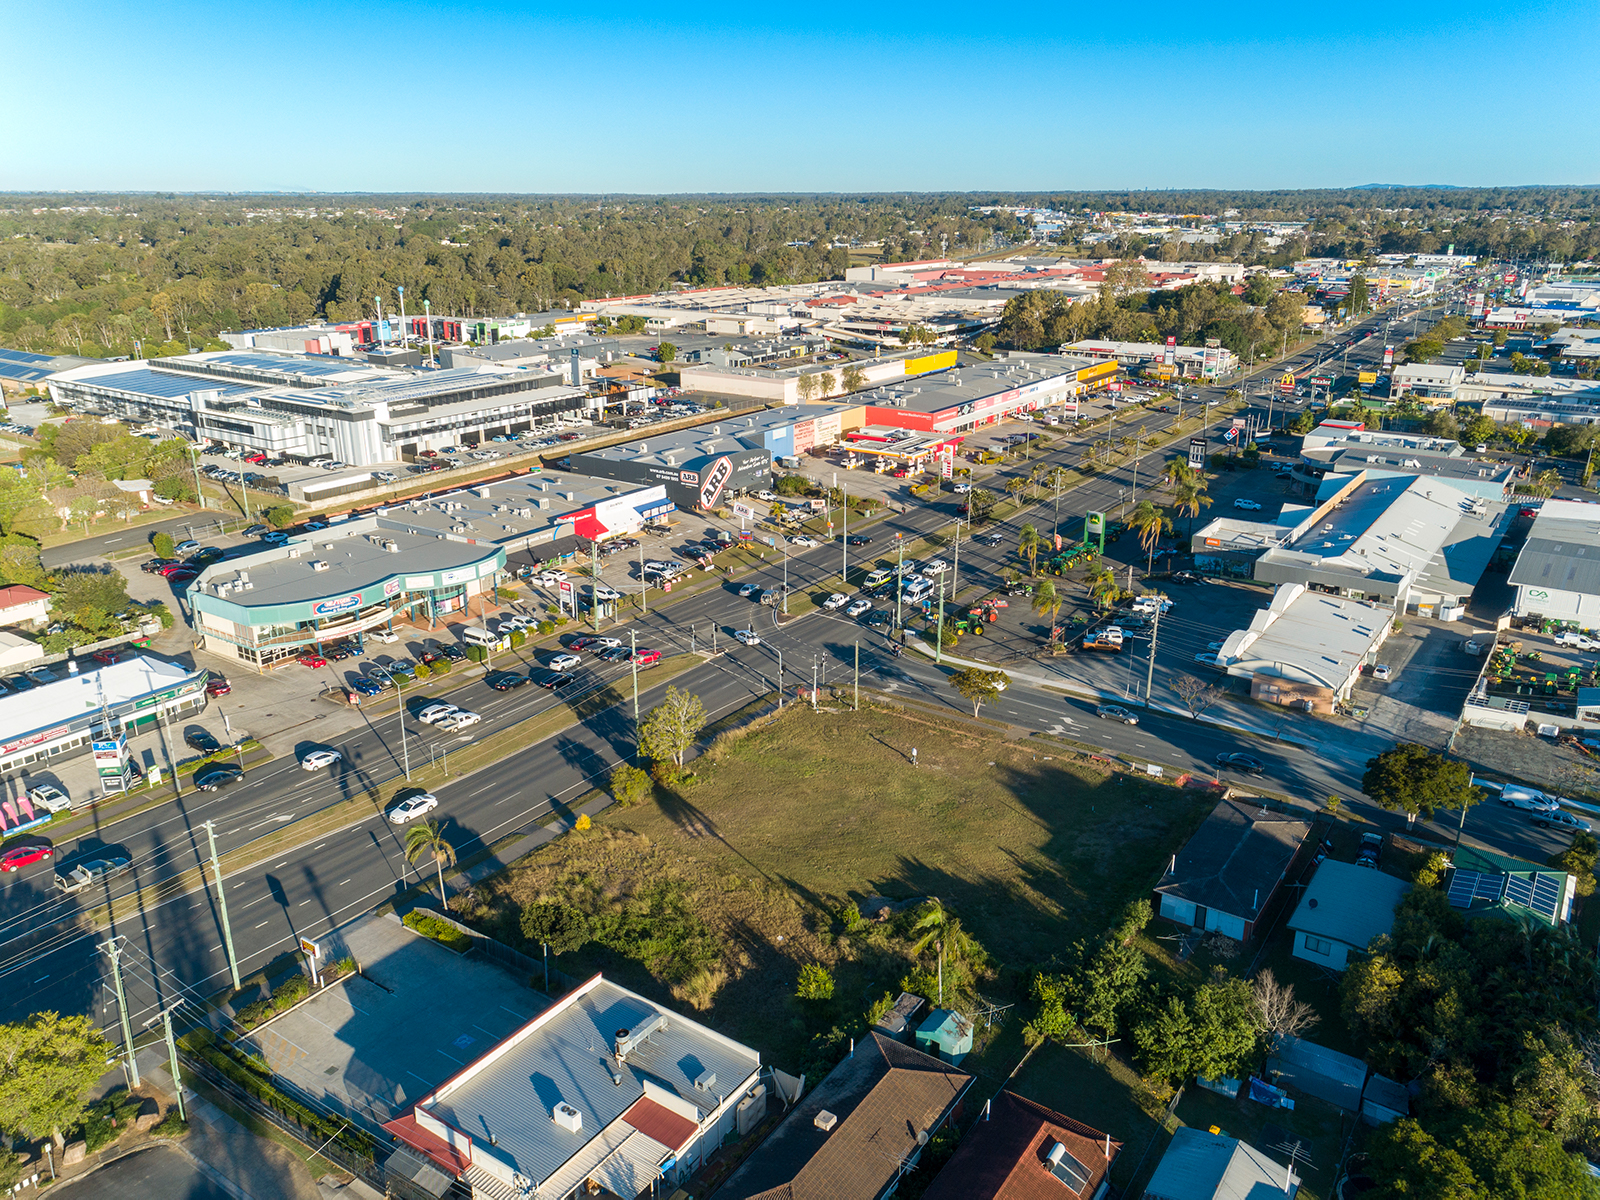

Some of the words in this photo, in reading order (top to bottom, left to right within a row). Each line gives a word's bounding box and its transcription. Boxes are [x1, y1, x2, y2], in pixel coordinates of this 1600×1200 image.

[682, 473, 697, 482] ARB
[702, 461, 729, 505] ARB
[736, 505, 749, 514] ARB
